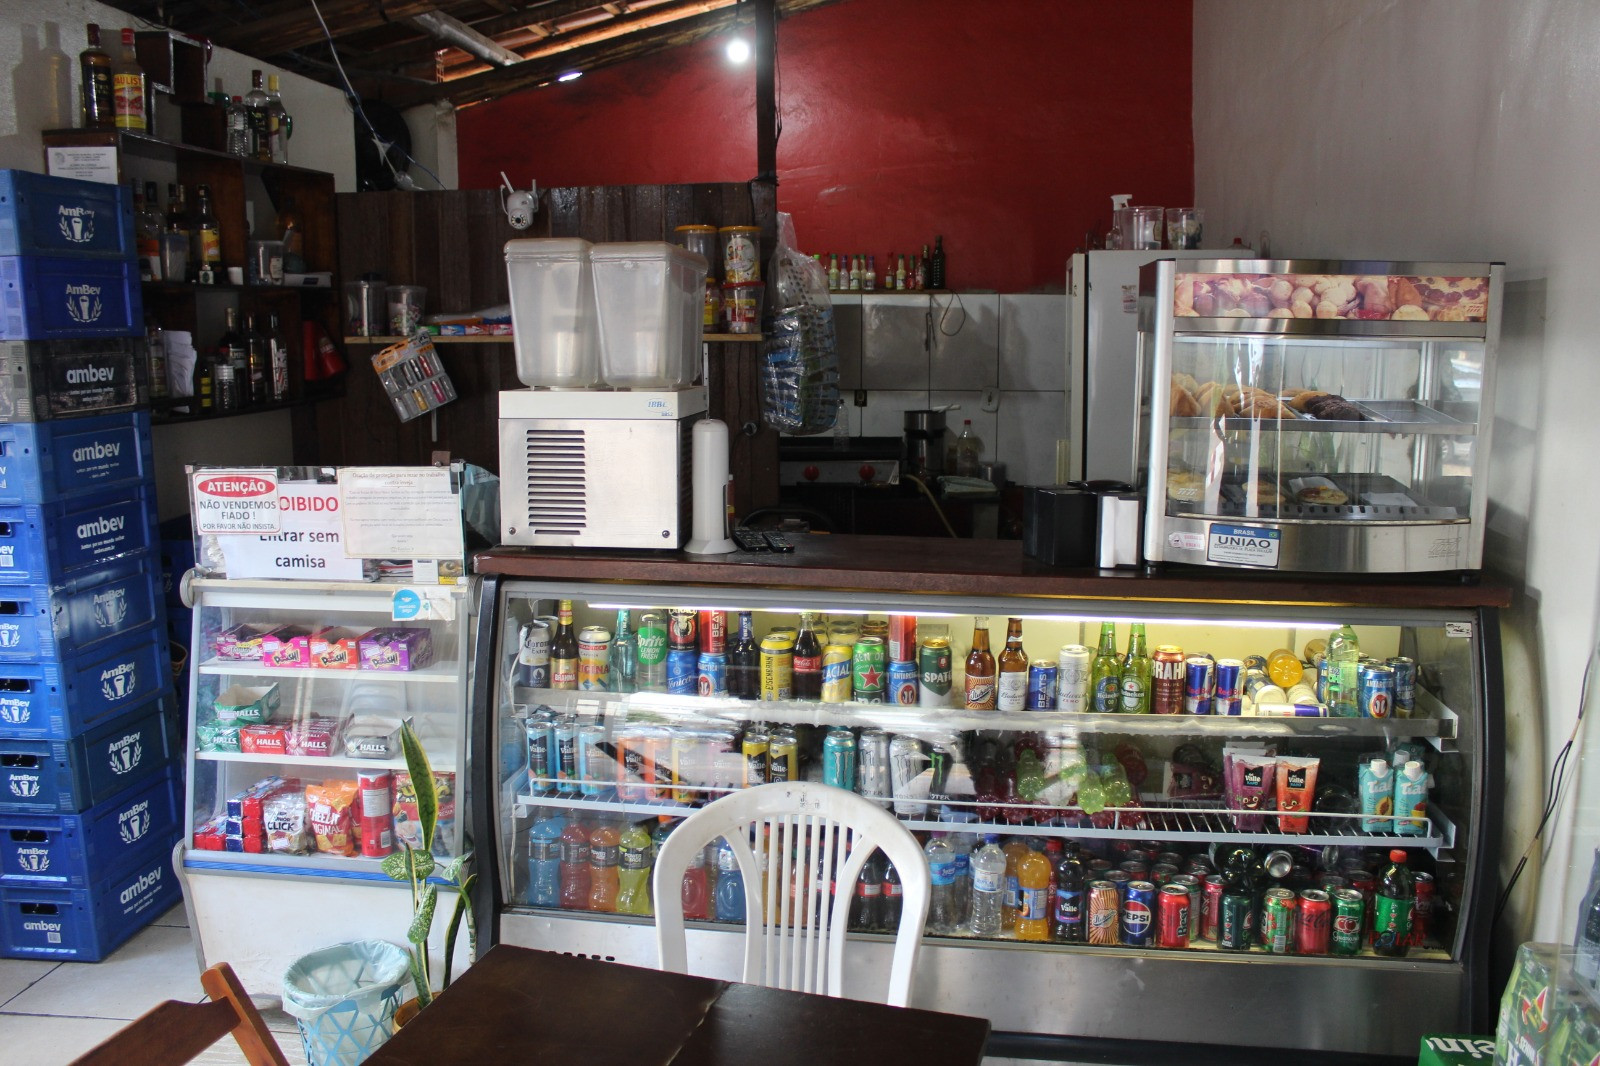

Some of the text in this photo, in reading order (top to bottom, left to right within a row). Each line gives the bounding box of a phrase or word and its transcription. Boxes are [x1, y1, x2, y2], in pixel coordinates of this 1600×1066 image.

[65, 284, 101, 295] AmBev
[66, 364, 114, 384] ambev
[72, 441, 120, 462] ambev
[207, 479, 266, 494] ATENÇÃO
[200, 499, 276, 509] NÃO VENDEMOS
[279, 496, 338, 511] OIBIDO
[221, 511, 250, 520] FIADO
[77, 515, 125, 539] ambev
[237, 522, 251, 530] NÃO
[309, 532, 339, 542] sem
[1233, 528, 1256, 536] BRASIL
[275, 554, 326, 568] camisa
[93, 588, 125, 604] AmBev
[711, 609, 719, 637] BEAT
[637, 633, 665, 648] Sprite
[100, 661, 135, 681] AmBev
[554, 673, 575, 681] BRAHMA
[924, 671, 952, 683] SPATE
[1037, 674, 1047, 708] BEATS
[1217, 686, 1231, 695] Red
[108, 731, 141, 754] AmBev
[213, 736, 238, 744] HALLS
[256, 738, 282, 746] HALLS
[301, 741, 328, 749] HALLS
[360, 743, 387, 752] HALLS
[9, 774, 39, 782] AmBev
[1244, 774, 1262, 782] Valle
[1287, 775, 1304, 783] Valle
[118, 800, 149, 824] AmBev
[267, 821, 295, 831] CLICK
[17, 847, 49, 855] AmBev
[119, 866, 162, 904] ambev
[1060, 904, 1078, 912] Valle
[1120, 910, 1150, 922] PEPSI
[24, 921, 61, 931] ambev
